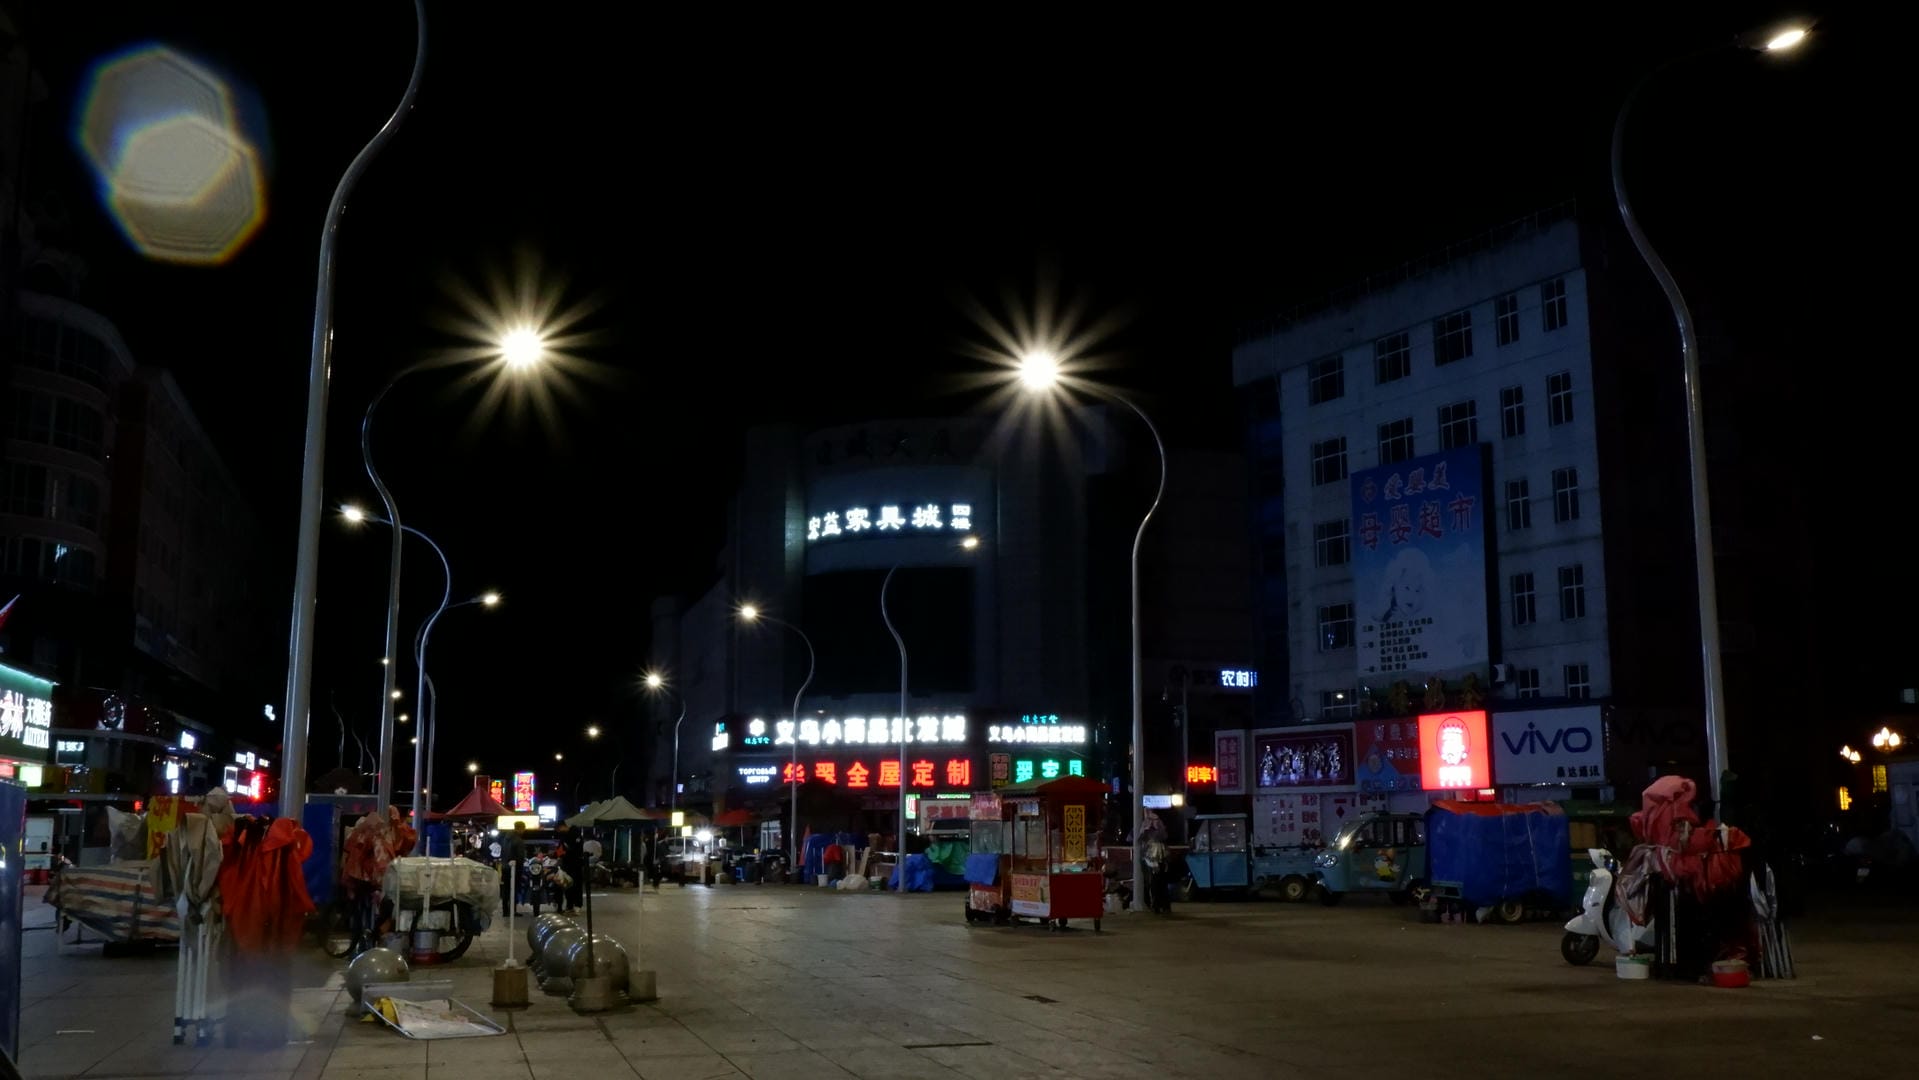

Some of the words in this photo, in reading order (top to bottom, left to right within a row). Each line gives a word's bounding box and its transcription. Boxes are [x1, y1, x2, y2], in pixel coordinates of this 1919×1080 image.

[1359, 491, 1475, 551] 母婴超市
[1501, 721, 1592, 755] vivo
